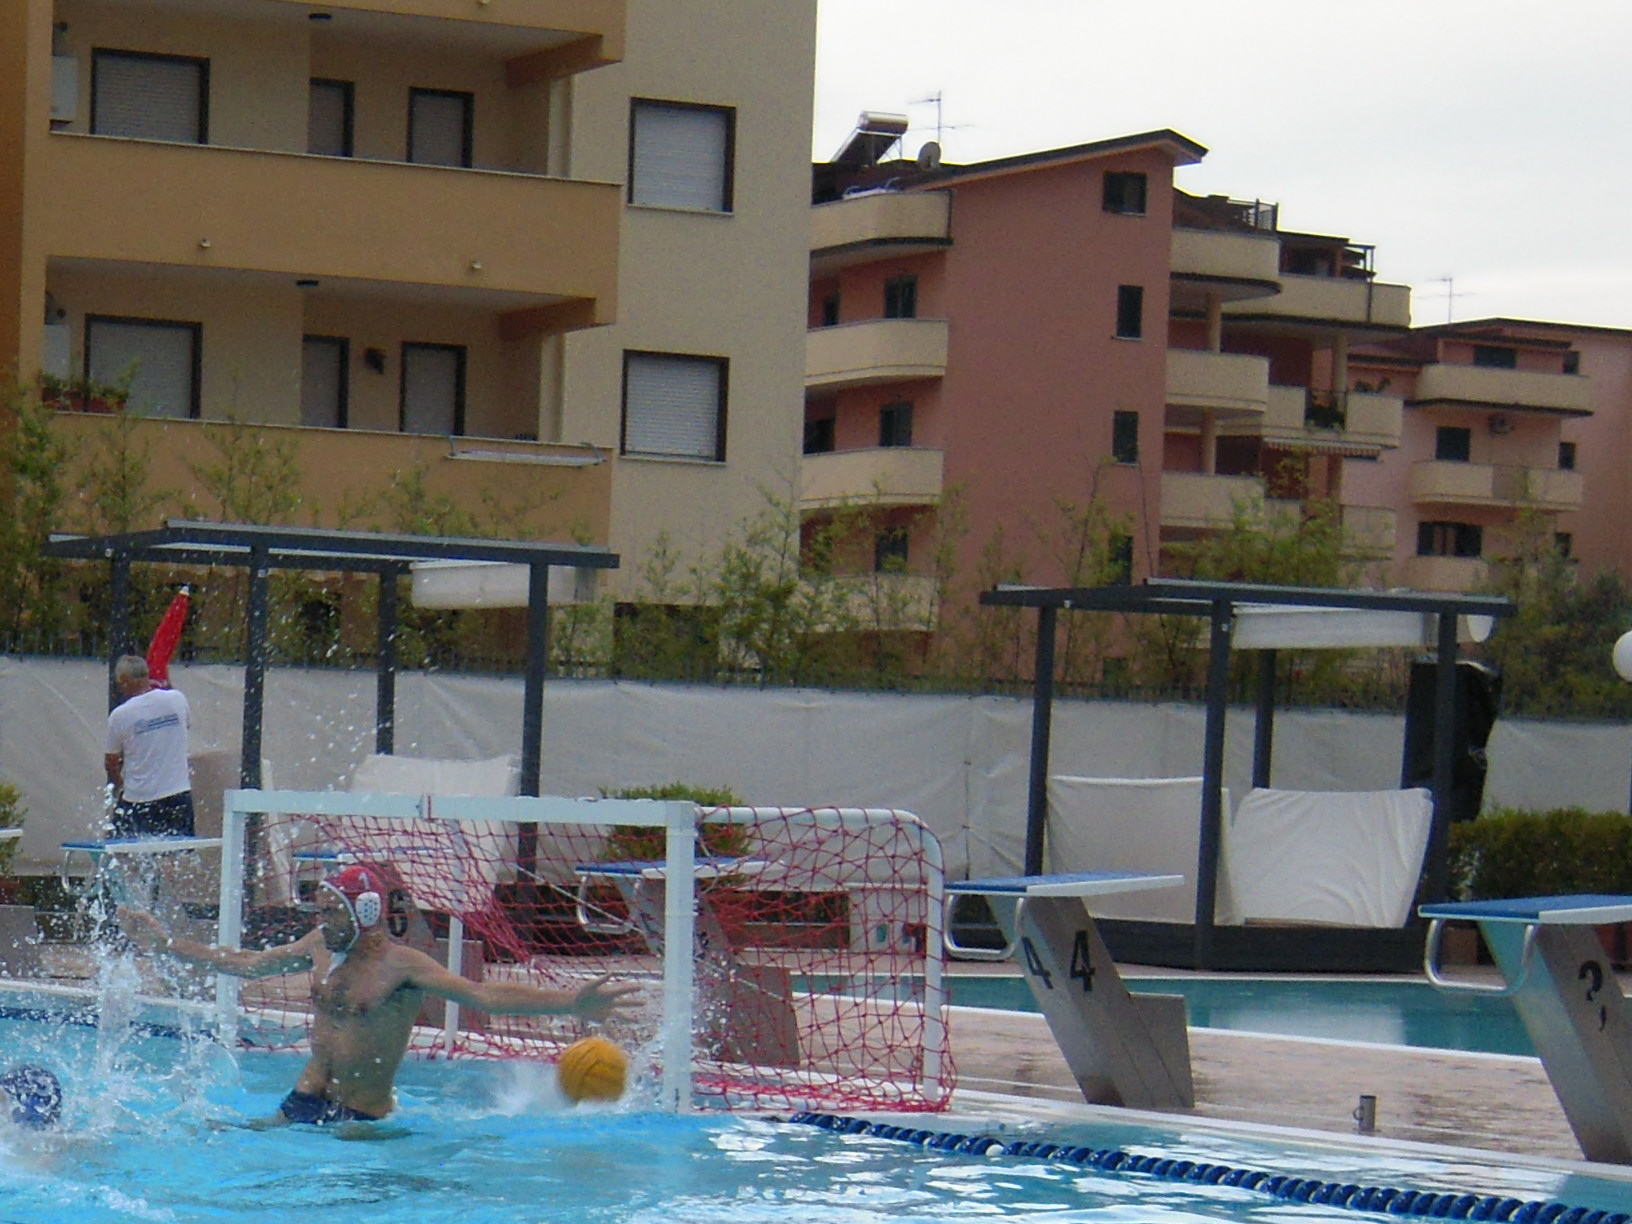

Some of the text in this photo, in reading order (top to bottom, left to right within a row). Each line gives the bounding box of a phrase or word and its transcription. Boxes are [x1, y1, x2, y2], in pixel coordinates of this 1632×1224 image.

[359, 871, 371, 890] 1
[1021, 936, 1054, 990] 4
[1070, 930, 1096, 992] 4
